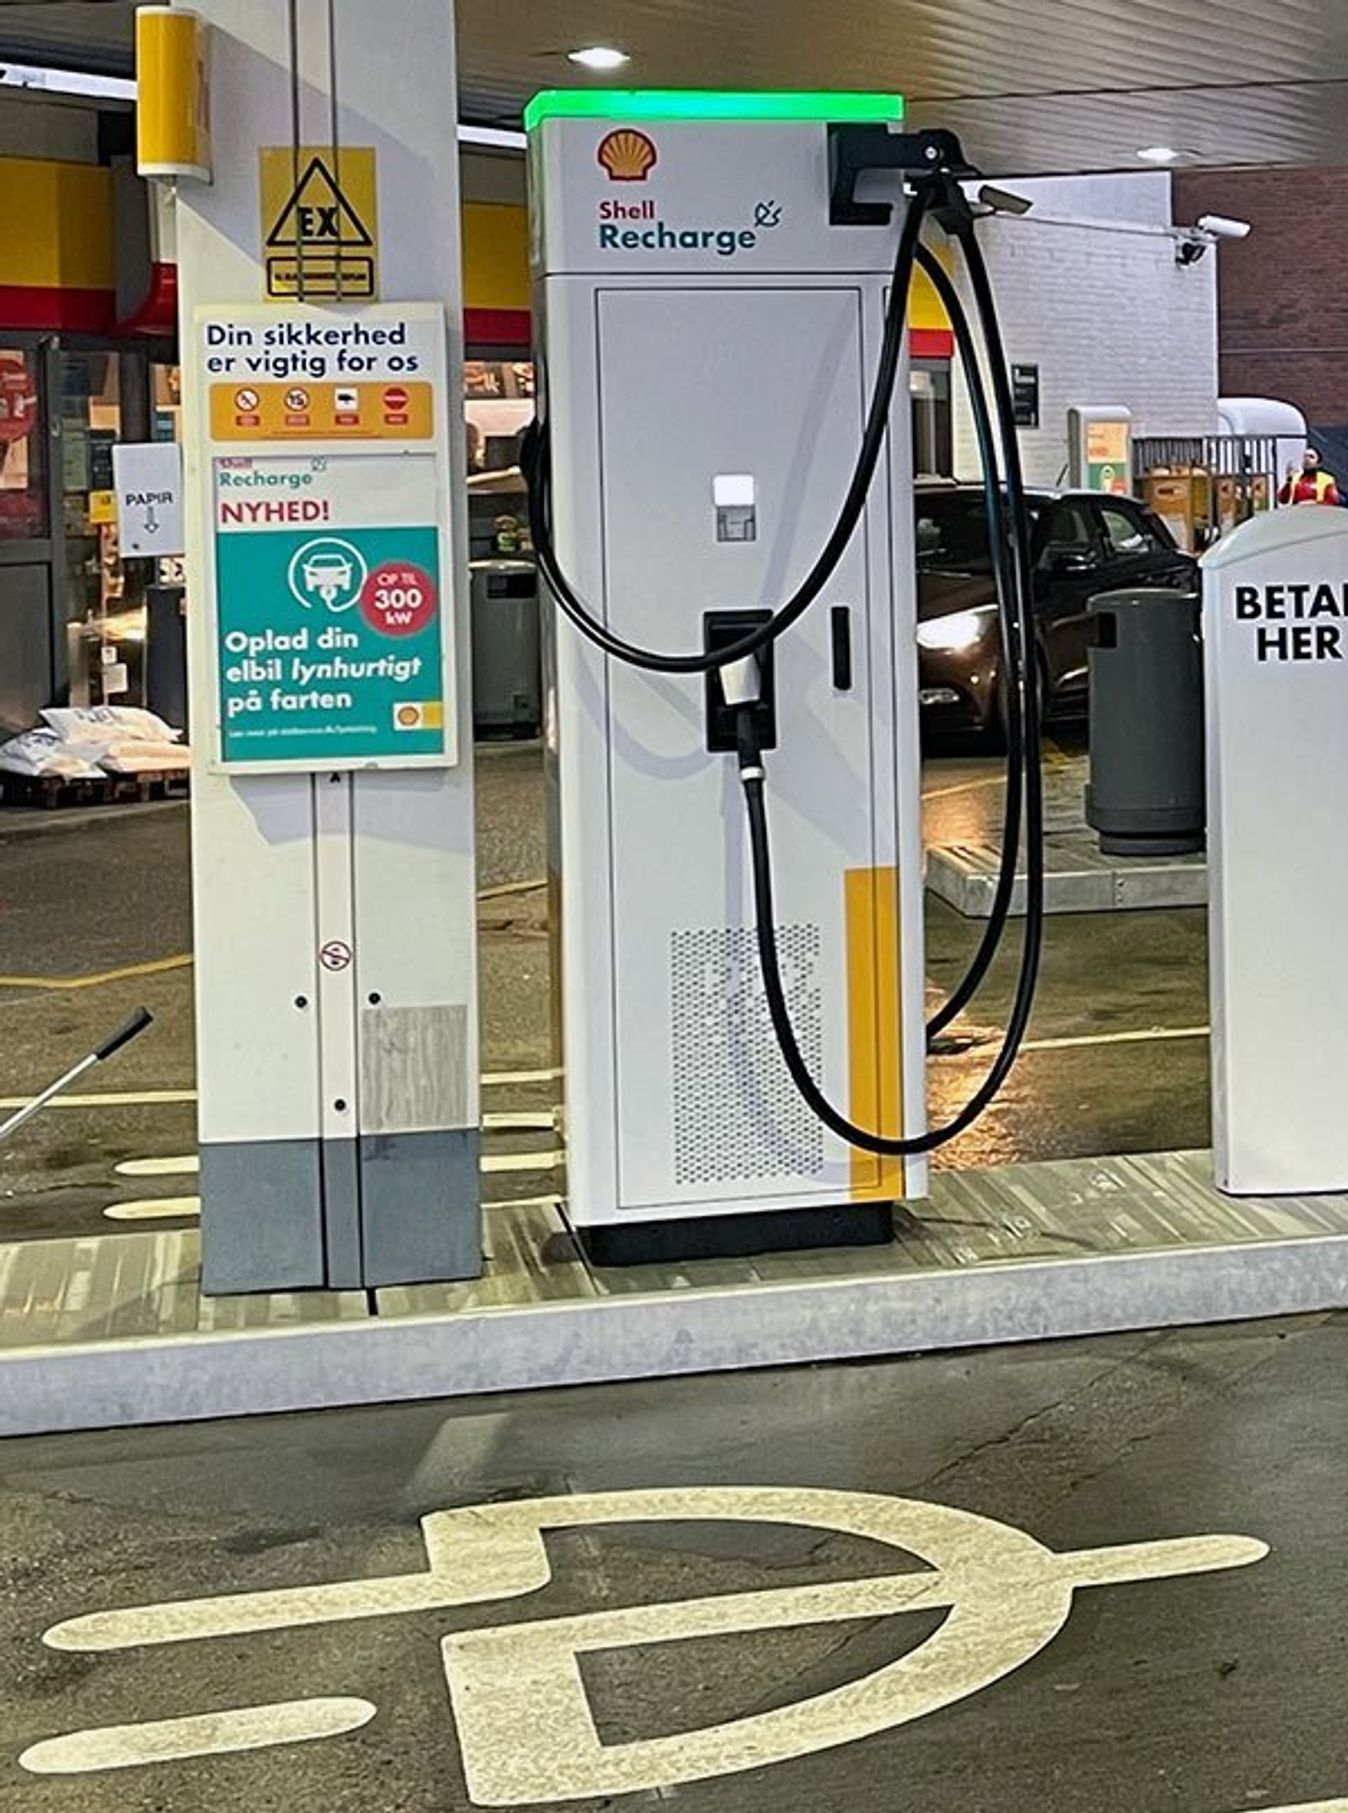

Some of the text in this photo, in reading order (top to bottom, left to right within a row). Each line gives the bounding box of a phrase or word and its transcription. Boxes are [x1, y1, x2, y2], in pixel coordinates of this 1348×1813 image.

[297, 206, 340, 238] EX
[600, 200, 655, 220] Shell
[599, 221, 757, 256] Recharge
[207, 321, 406, 346] Din sikkerhed
[207, 348, 419, 378] er vigtig for os
[219, 471, 313, 489] Recharge
[125, 491, 174, 507] PAPIR
[220, 500, 330, 524] NYHED!
[377, 572, 419, 586] OP TIL
[374, 588, 424, 610] 300
[385, 611, 413, 626] kW
[225, 627, 359, 657] Oplad din
[1257, 625, 1343, 662] HER
[226, 653, 422, 686] elbil lynhurtigt
[227, 688, 352, 718] på farten
